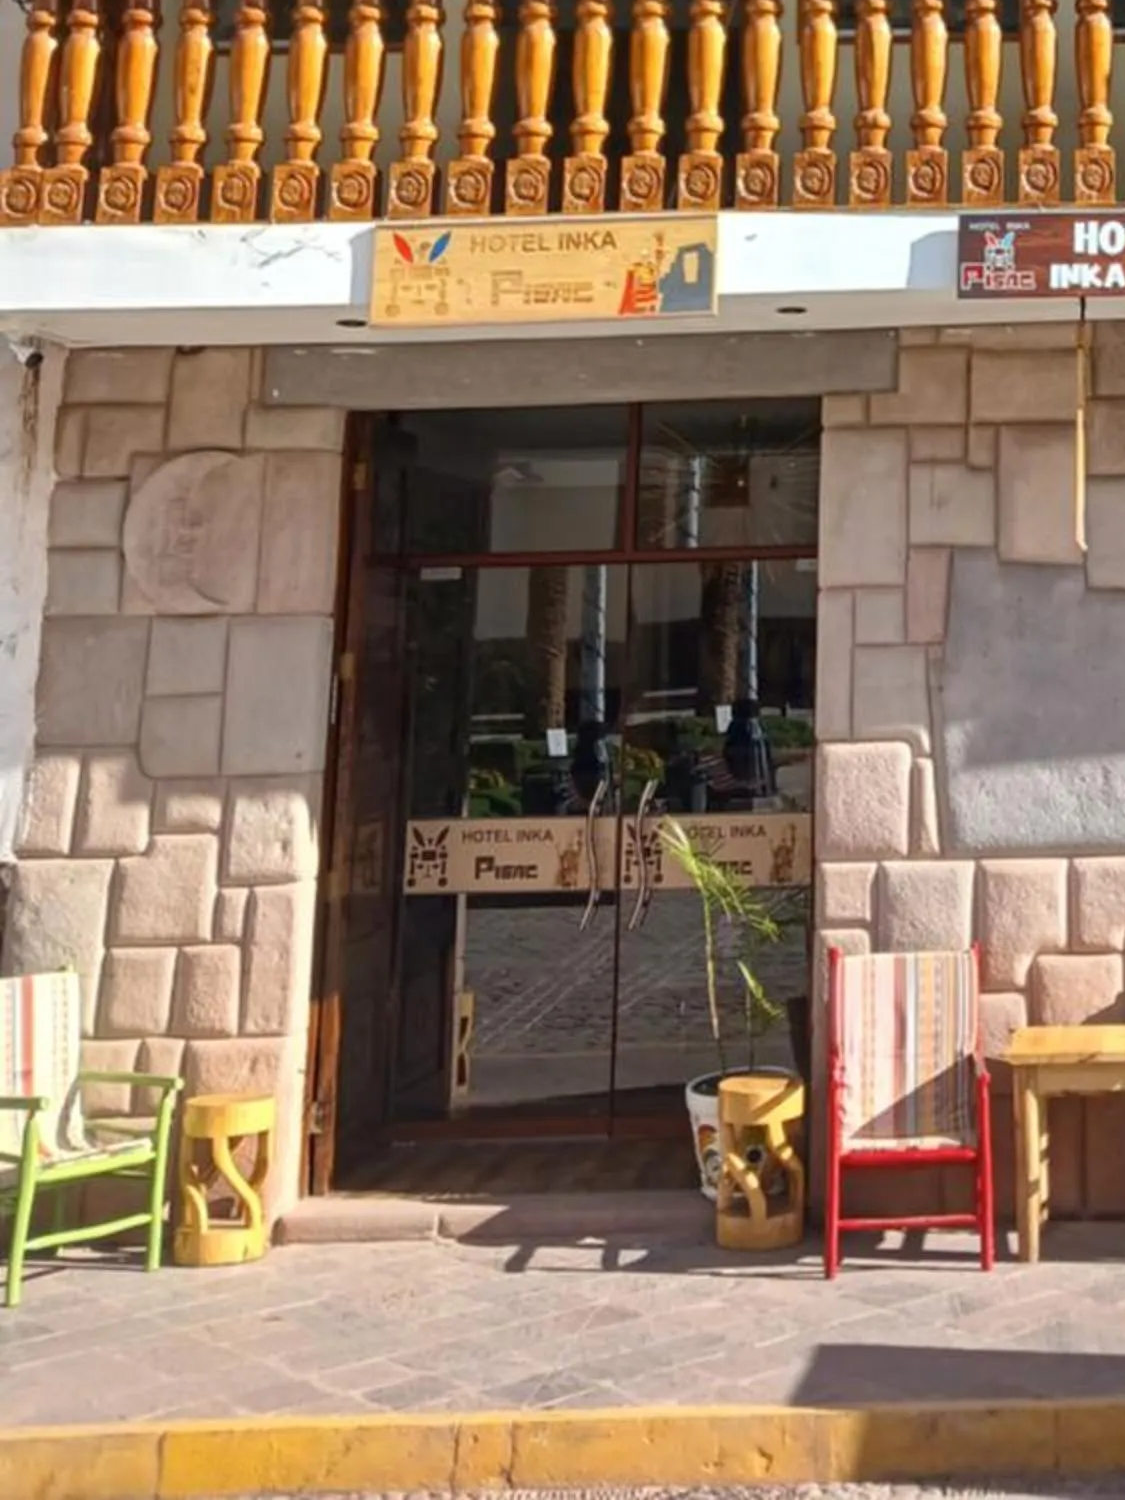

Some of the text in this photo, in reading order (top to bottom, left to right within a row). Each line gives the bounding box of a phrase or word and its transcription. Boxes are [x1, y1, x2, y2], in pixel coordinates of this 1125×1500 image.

[469, 230, 618, 254] HOTEL INKA
[461, 828, 554, 844] HOTEL INKA
[682, 824, 767, 840] OTEL INKA
